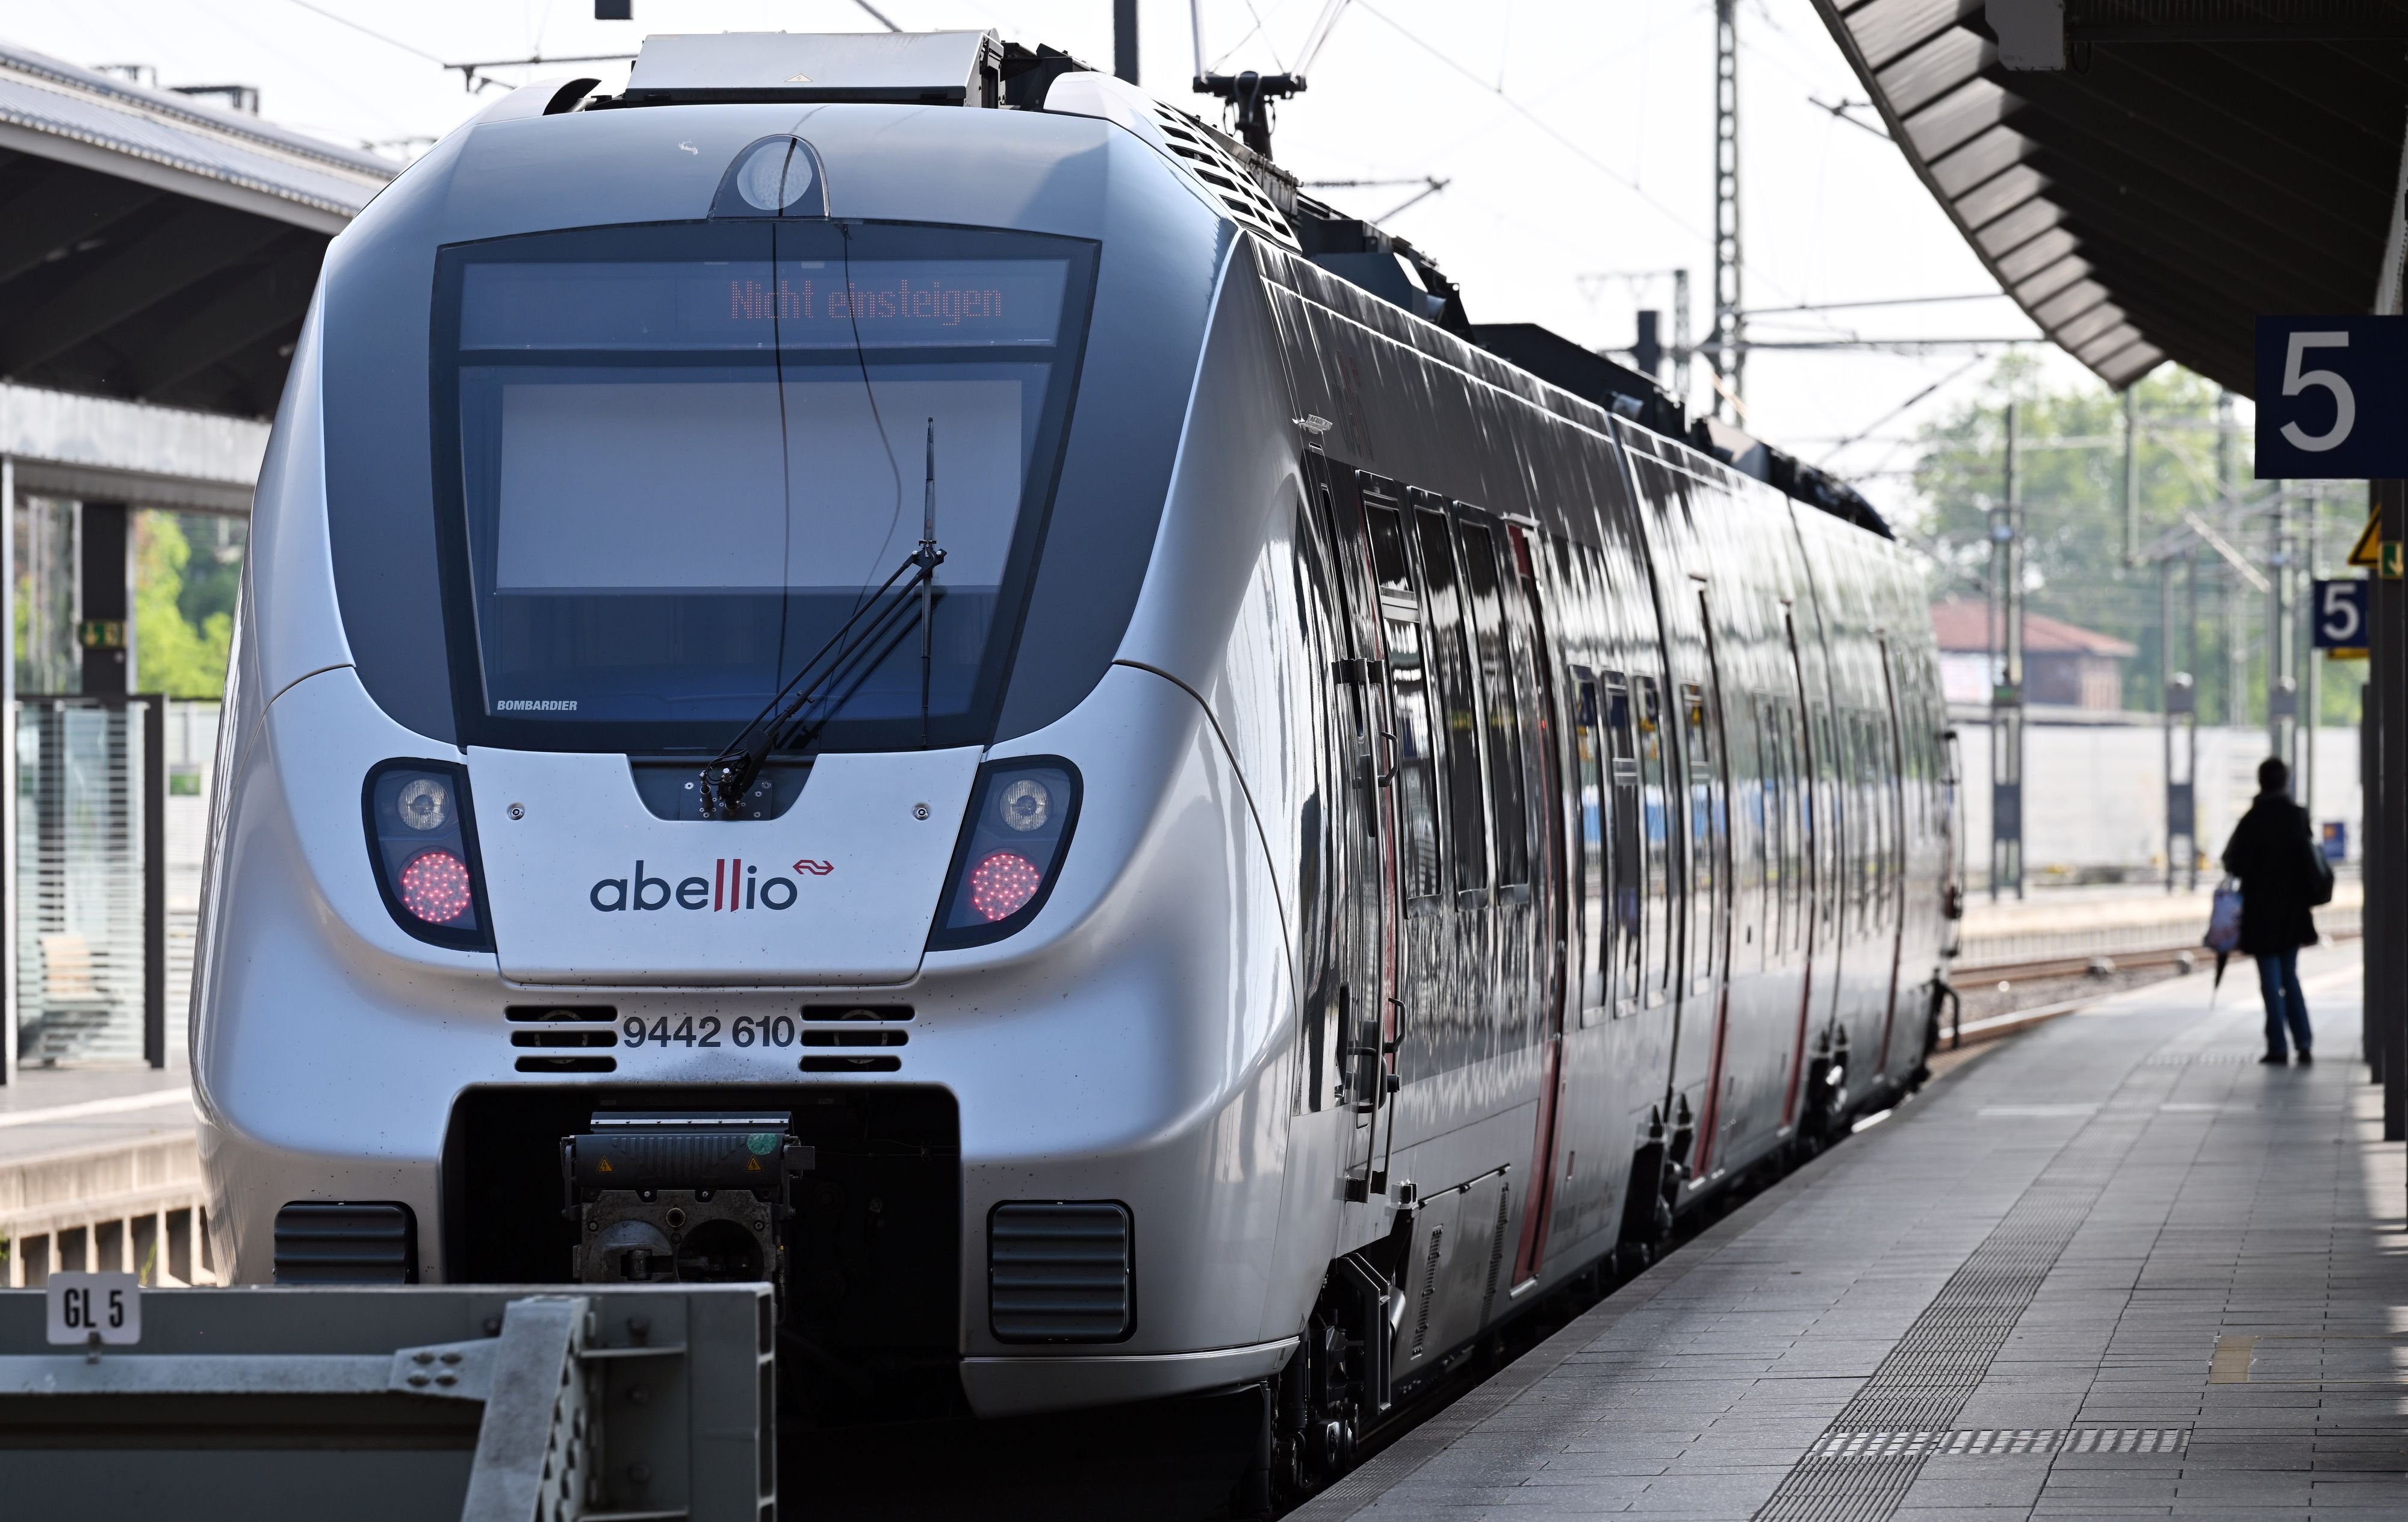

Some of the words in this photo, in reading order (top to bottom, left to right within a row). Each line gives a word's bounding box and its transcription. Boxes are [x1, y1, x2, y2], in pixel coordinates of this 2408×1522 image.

[731, 280, 813, 318] Nicht
[828, 279, 1001, 326] einsteigen
[2280, 331, 2356, 452] 5
[2323, 583, 2359, 640] 5
[497, 700, 577, 711] BOMBARDIER
[589, 858, 799, 913] abellio
[622, 1016, 722, 1048] 9442
[731, 1015, 796, 1048] 610
[63, 1288, 98, 1328] GL
[108, 1290, 125, 1329] 5
